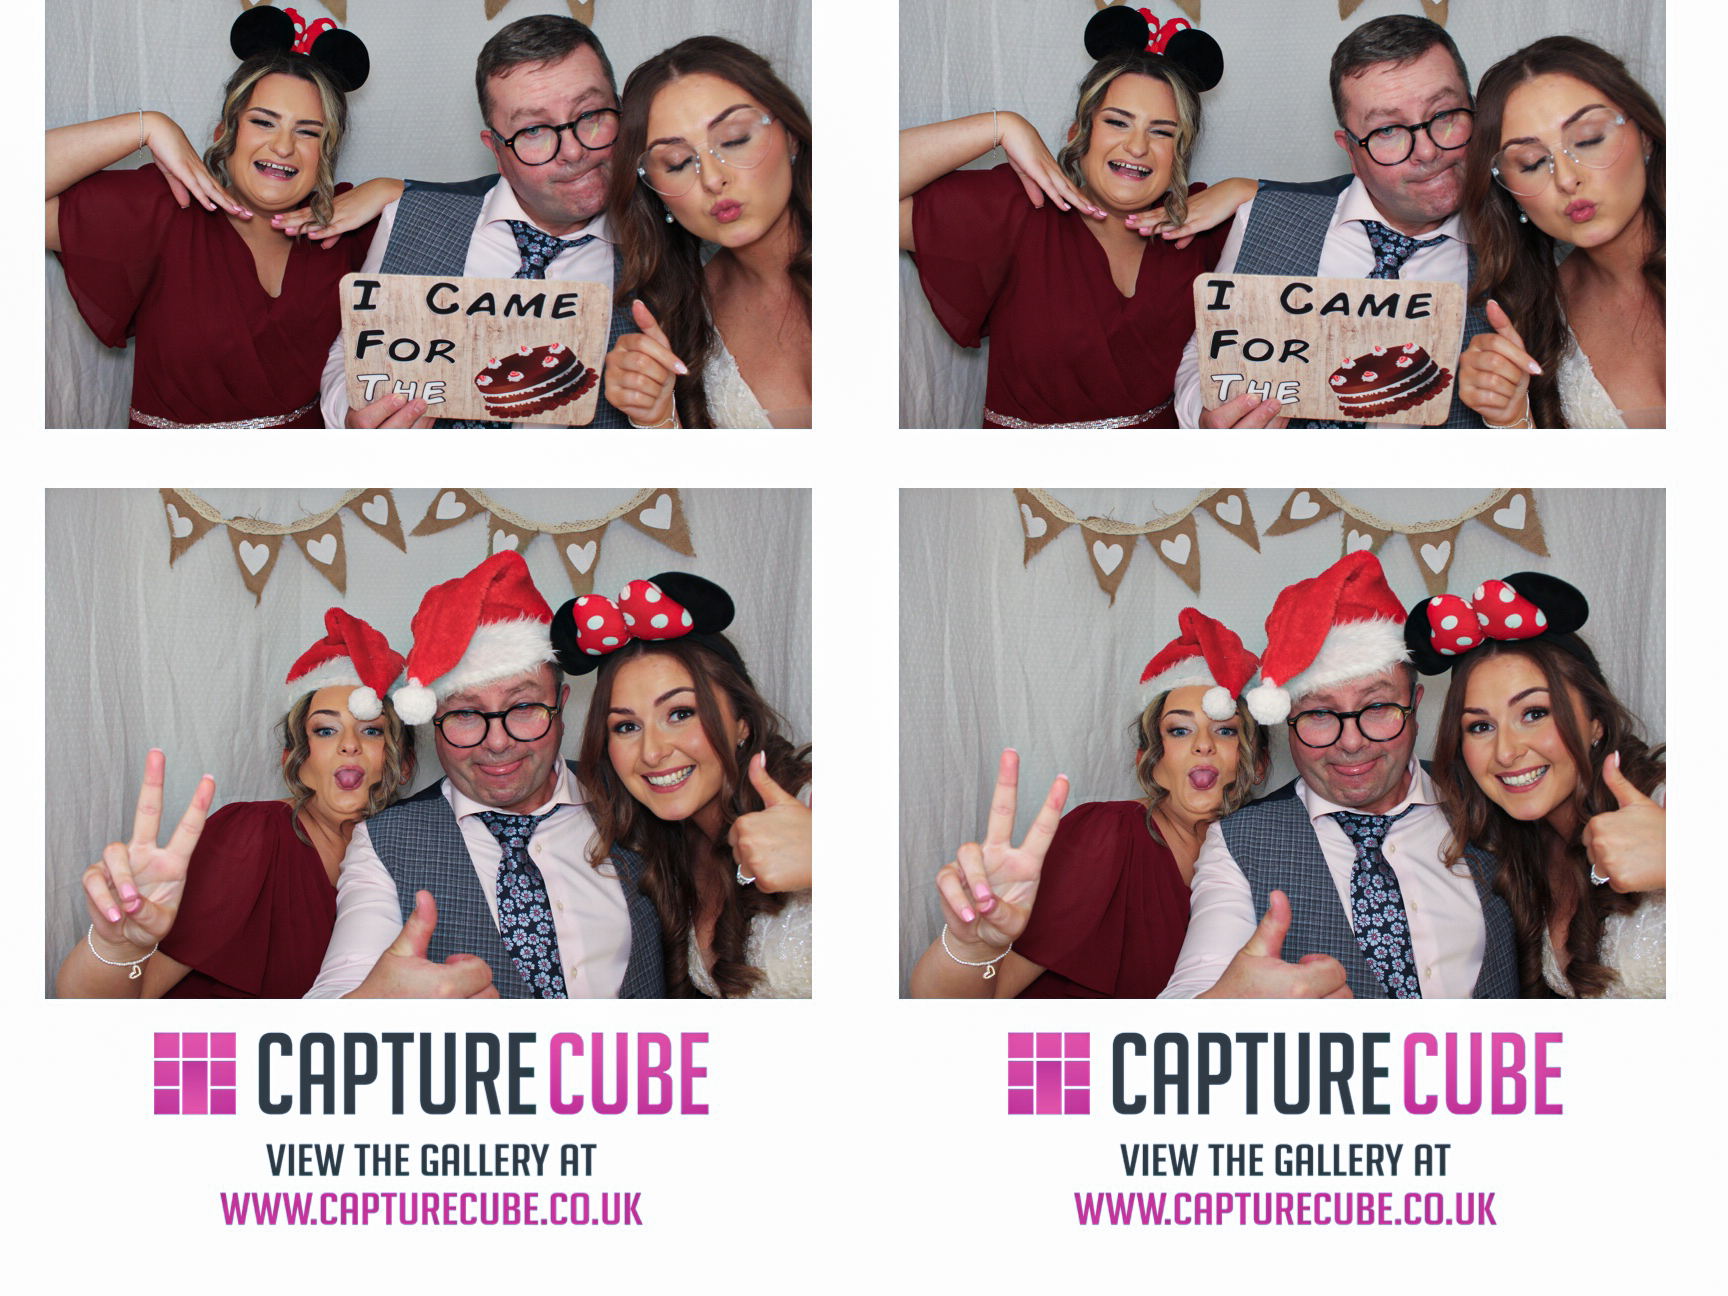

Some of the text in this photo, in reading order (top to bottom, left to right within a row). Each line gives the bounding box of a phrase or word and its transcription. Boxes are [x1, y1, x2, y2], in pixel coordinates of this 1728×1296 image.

[353, 280, 579, 320] I CAME
[1207, 280, 1433, 320] I CAME
[355, 329, 456, 364] FOR
[1209, 329, 1310, 364] FOR
[356, 373, 447, 406] THE
[1210, 373, 1301, 406] THE
